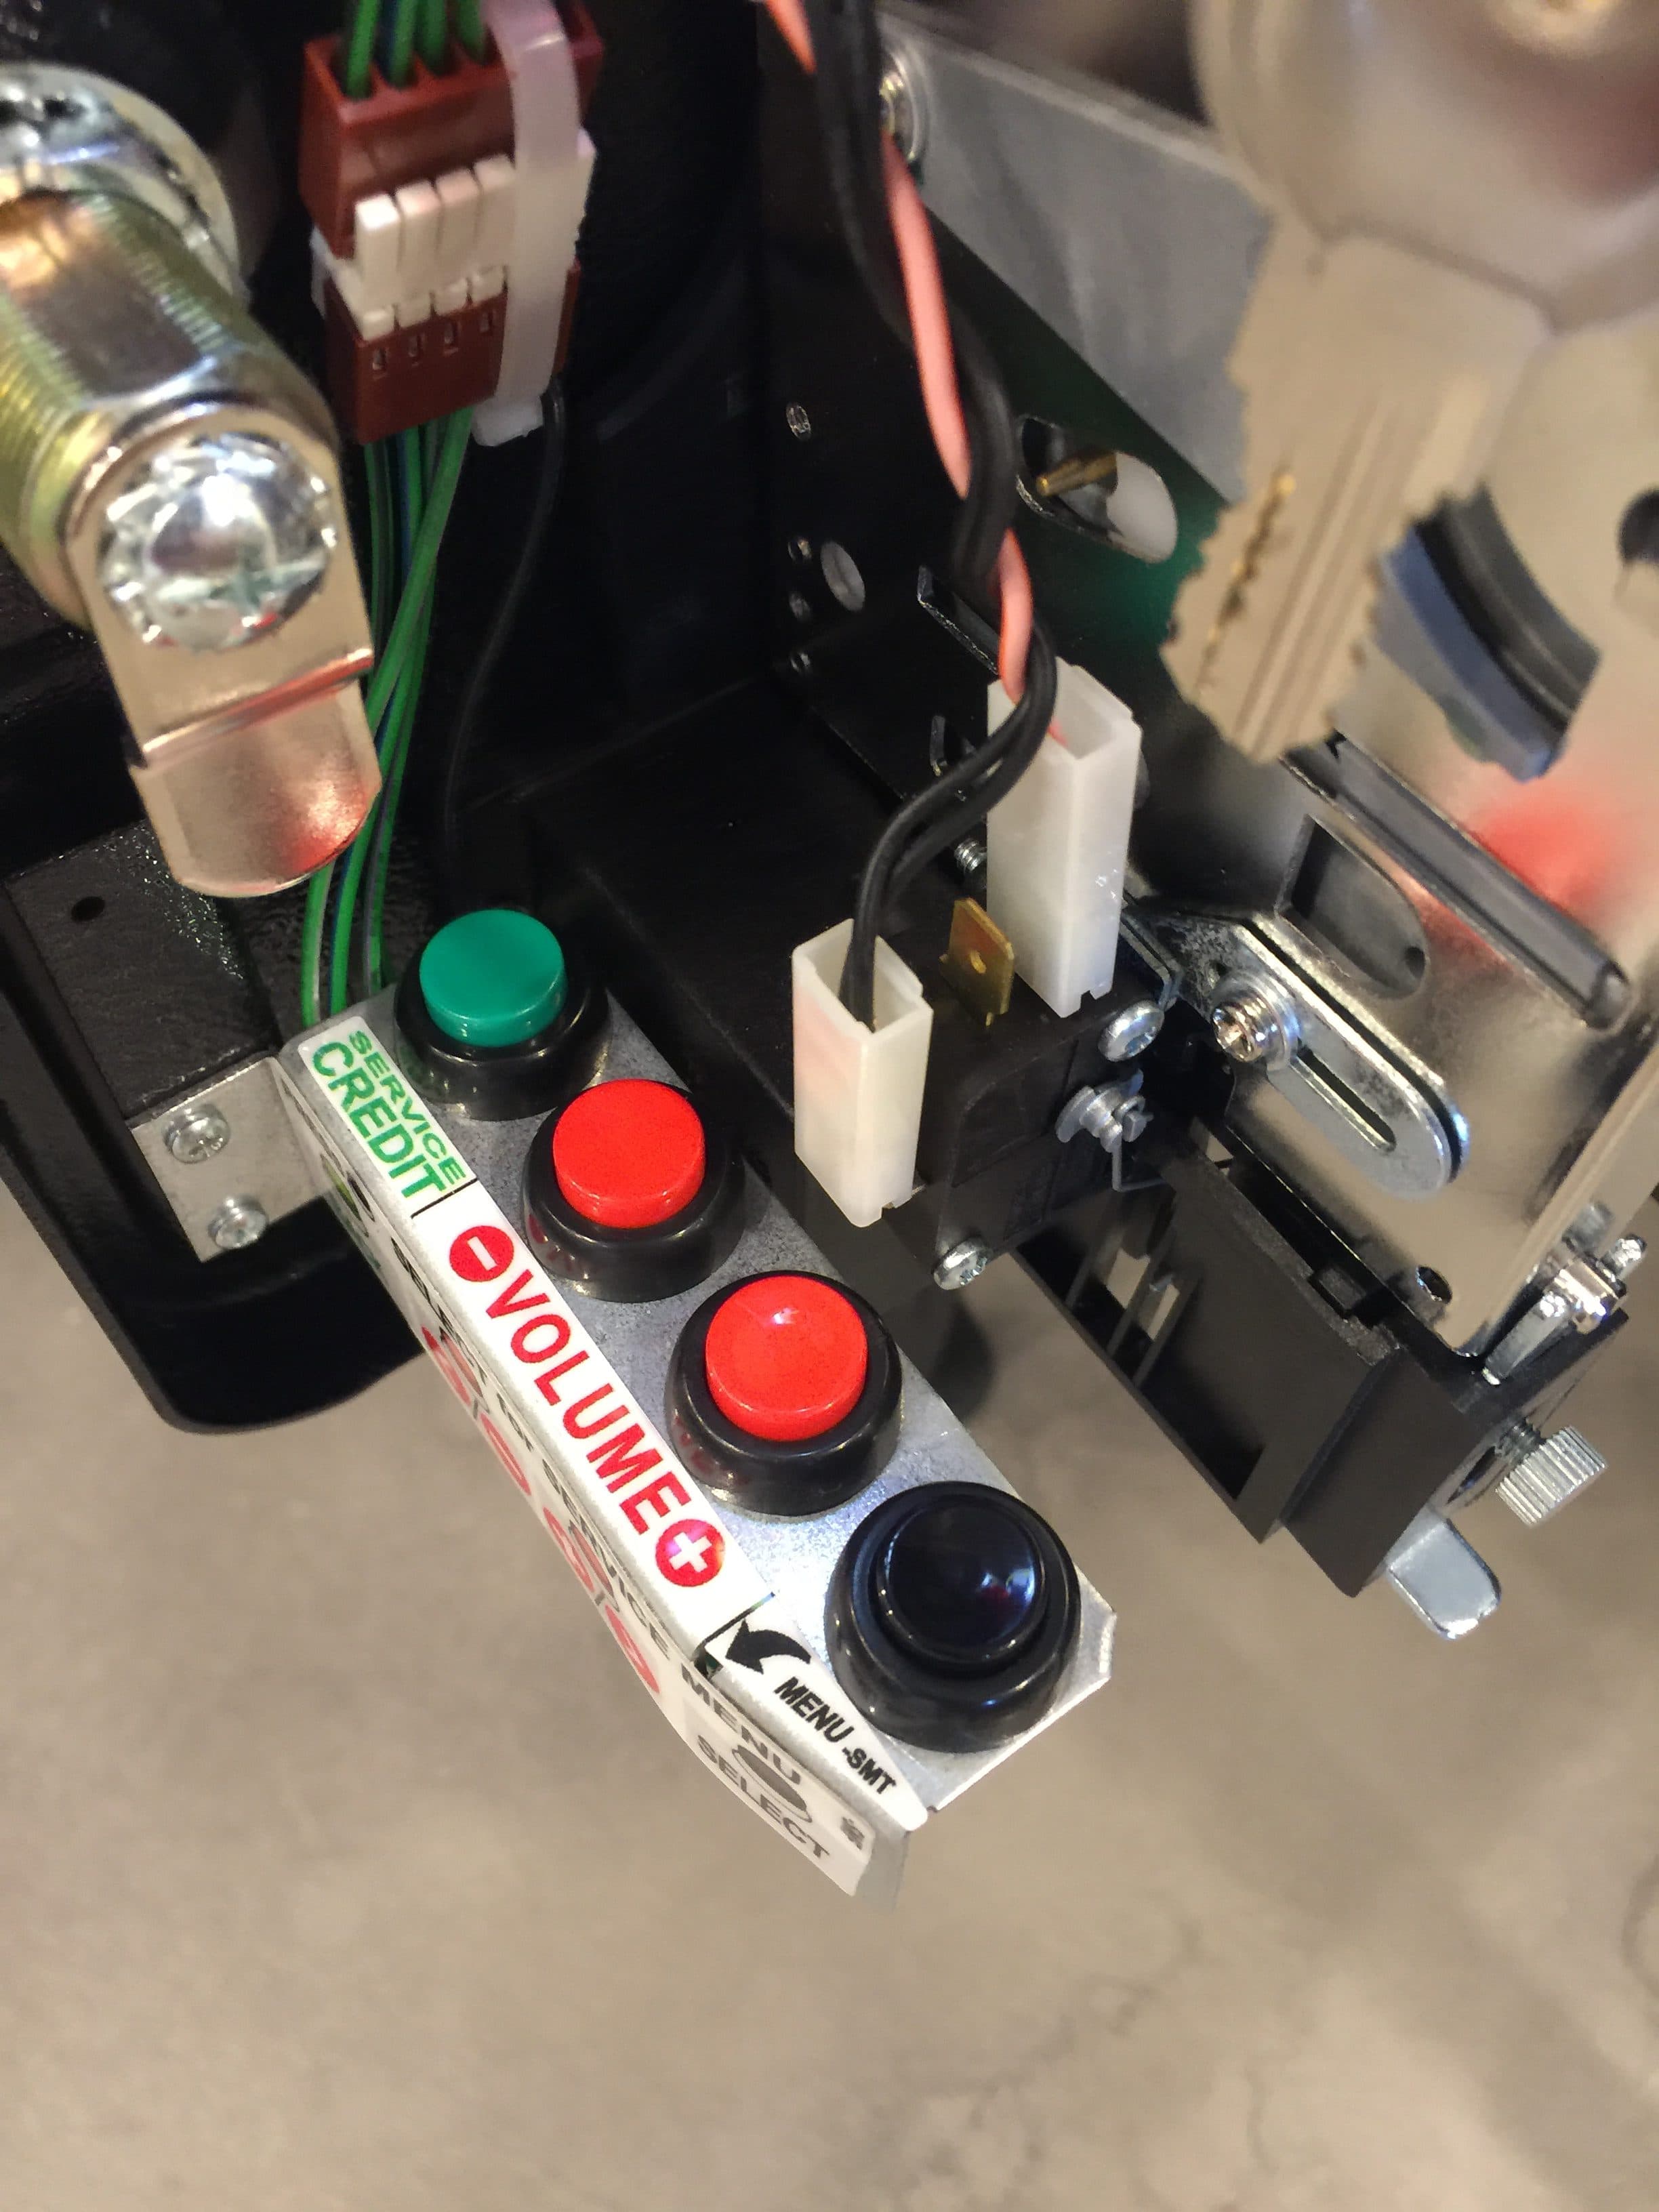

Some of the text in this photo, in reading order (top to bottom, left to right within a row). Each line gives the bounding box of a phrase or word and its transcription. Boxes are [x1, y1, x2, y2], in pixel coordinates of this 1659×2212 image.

[312, 1041, 447, 1199] CREDIT
[349, 1029, 466, 1185] SERVICE
[485, 1269, 691, 1536] VOLUME
[681, 1662, 802, 1786] MENU
[773, 1676, 855, 1743] MENU
[697, 1734, 831, 1858] SELECT
